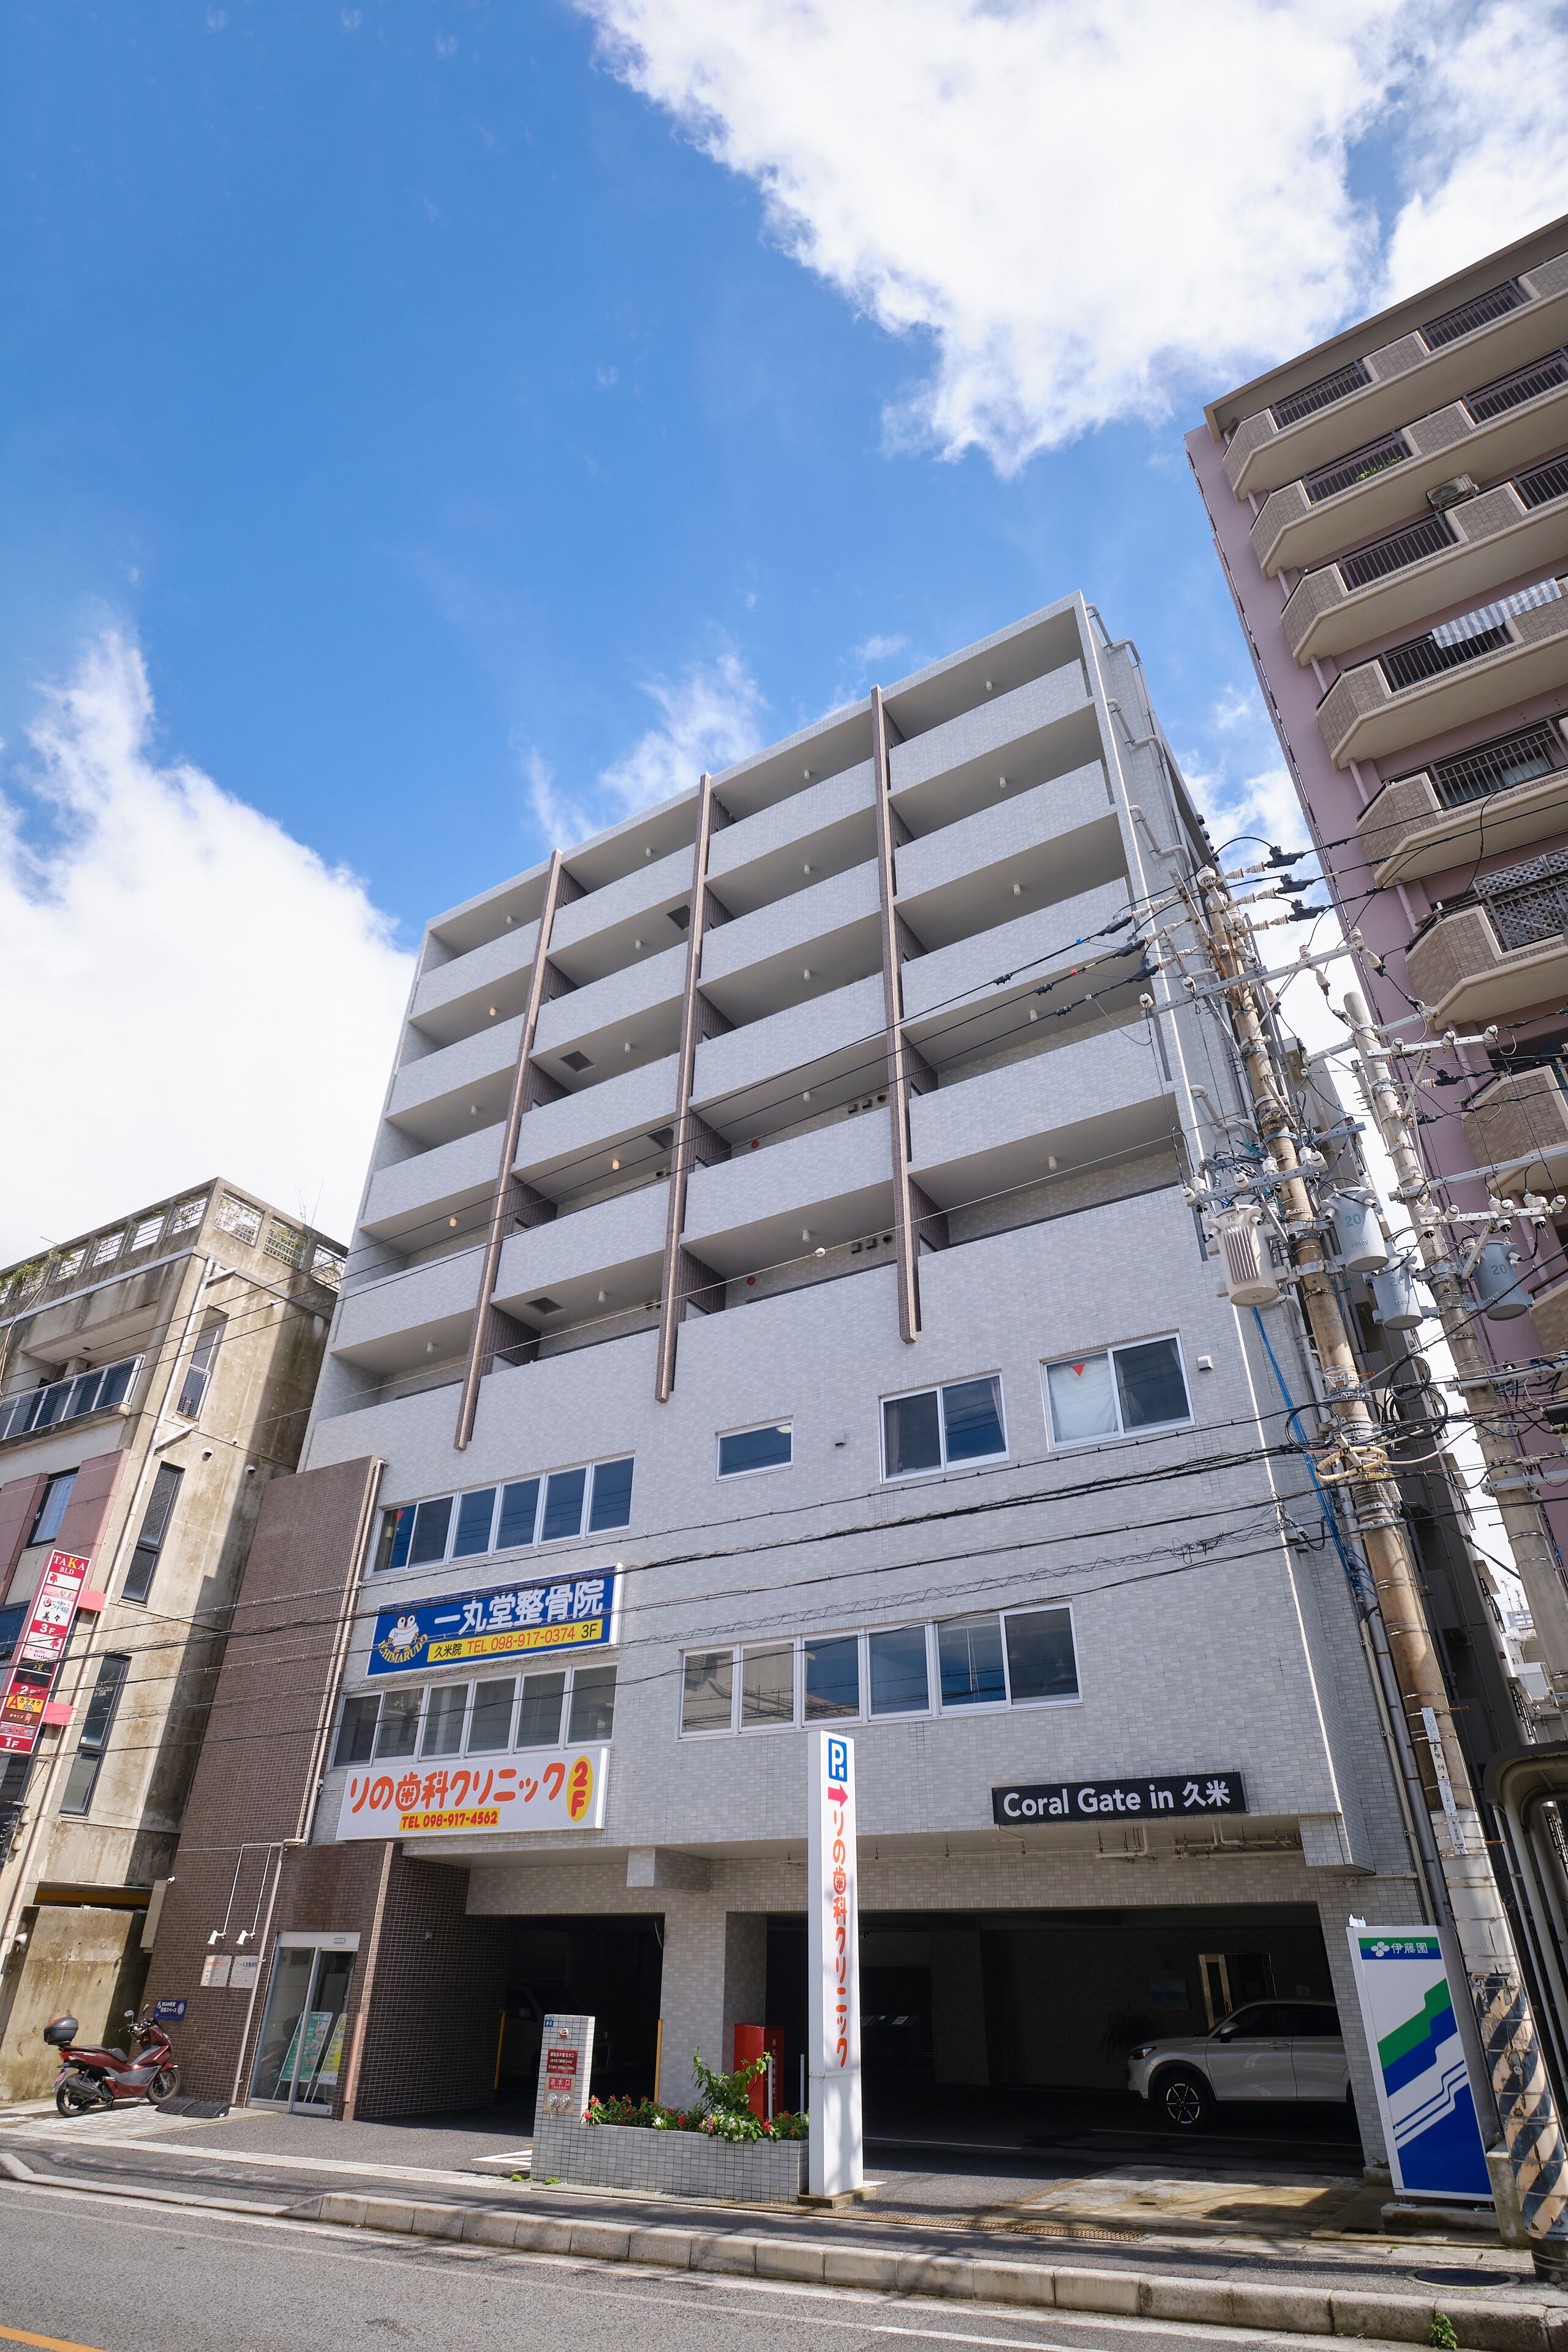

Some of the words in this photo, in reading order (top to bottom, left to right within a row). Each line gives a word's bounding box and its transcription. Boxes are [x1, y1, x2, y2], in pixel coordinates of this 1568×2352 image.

[1226, 1214, 1235, 1223] 75
[1345, 1213, 1362, 1226] 20
[1351, 1239, 1370, 1248] 6600V
[1491, 1264, 1507, 1275] 20
[1389, 1275, 1404, 1286] 20
[53, 1555, 85, 1571] TAKA
[59, 1566, 75, 1575] BLD
[434, 1579, 605, 1635] 一丸堂整骨院
[39, 1623, 56, 1634] 3F
[434, 1643, 462, 1659] 久米院
[467, 1640, 488, 1654] TEL
[491, 1626, 575, 1649] 098-917-0374
[581, 1623, 598, 1638] 3F
[377, 1633, 428, 1664] ICHIMARUDO
[20, 1685, 37, 1696] 2F
[8, 1695, 18, 1709] A
[6, 1737, 20, 1747] 1F
[831, 1742, 844, 1777] P
[350, 1762, 565, 1814] リの歯科クリニック
[570, 1760, 589, 1818] 2F
[1003, 1788, 1069, 1817] Coral
[1077, 1787, 1141, 1813] Gate
[1149, 1784, 1174, 1809] in
[1182, 1780, 1231, 1808] 久米
[402, 1815, 420, 1830] TEL
[423, 1811, 497, 1828] 098-917-4562
[832, 1809, 848, 2068] リの歯科クリニック
[1390, 1942, 1428, 1954] 伊藤園
